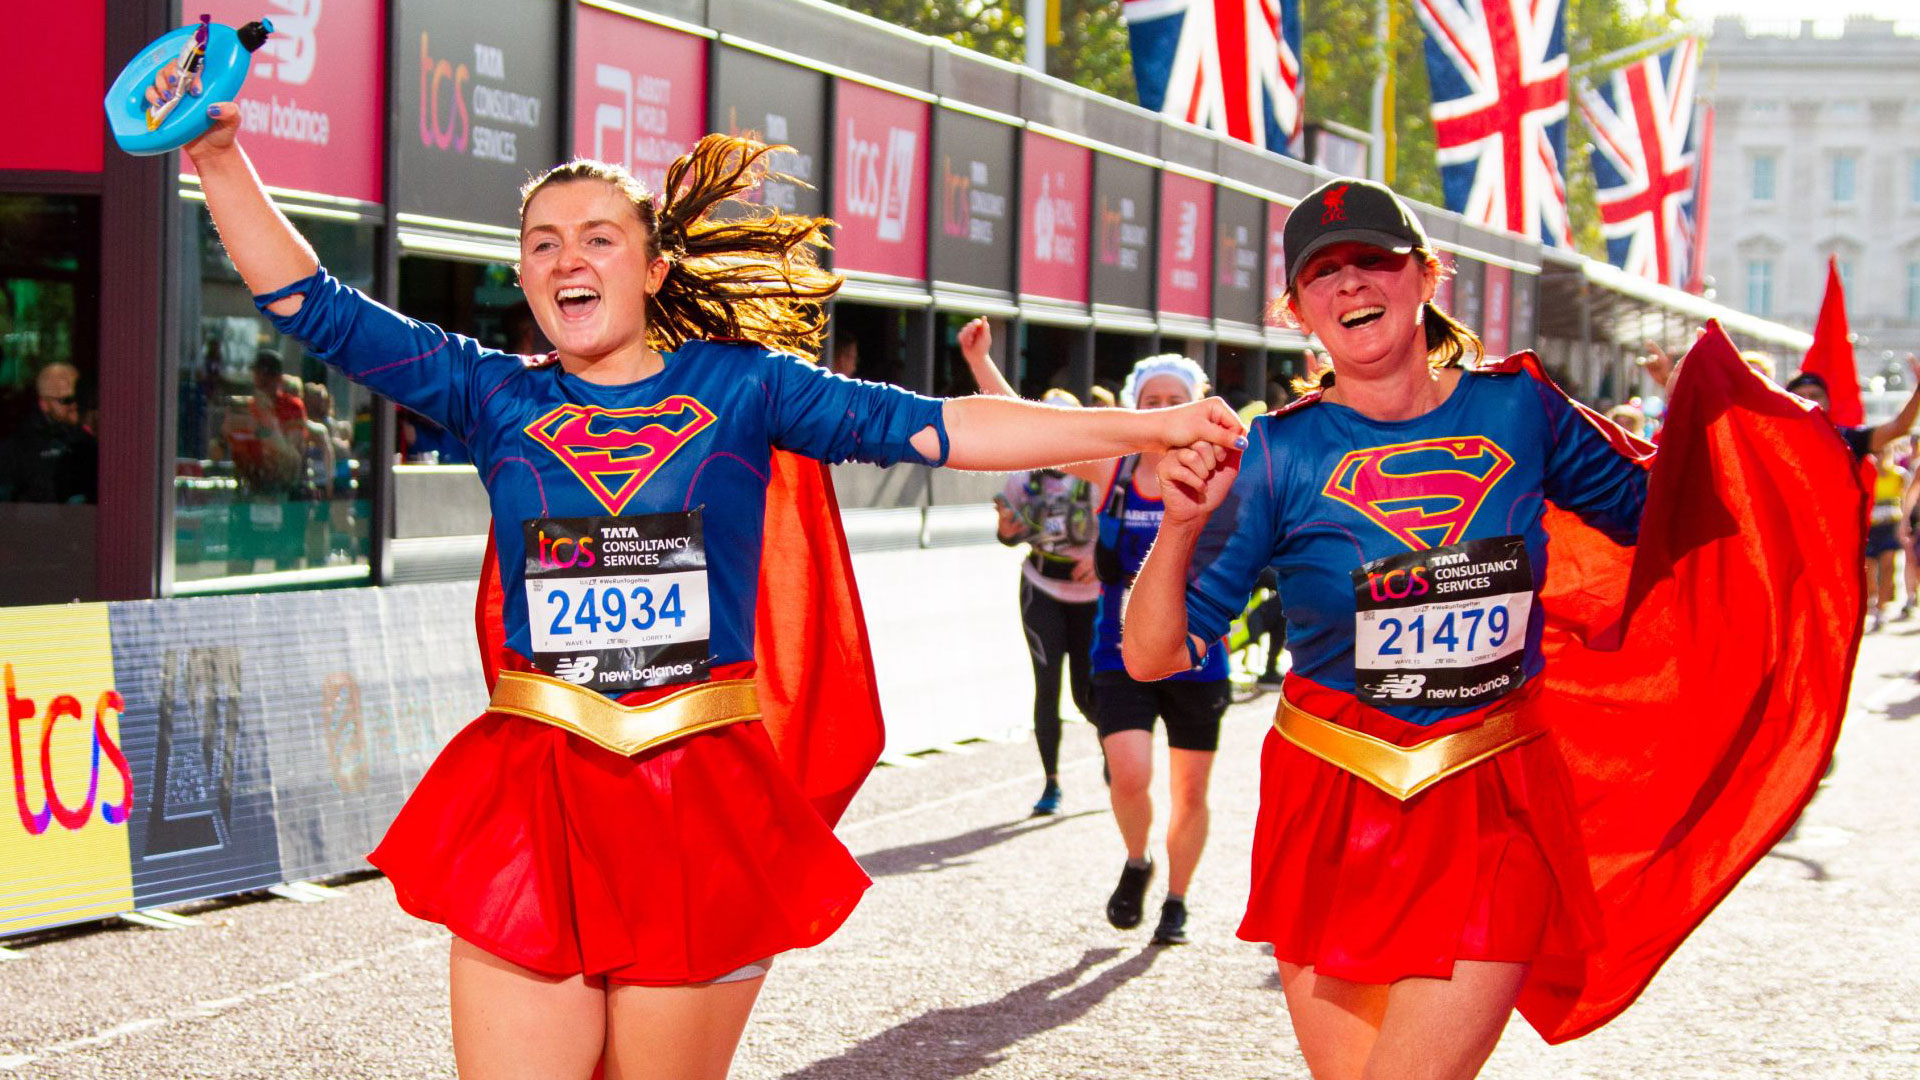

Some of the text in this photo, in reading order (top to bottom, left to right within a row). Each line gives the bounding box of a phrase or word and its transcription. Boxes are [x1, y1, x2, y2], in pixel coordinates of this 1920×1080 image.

[420, 30, 469, 153] tcs
[271, 95, 329, 147] balance
[846, 118, 880, 217] tcs
[601, 527, 639, 538] TATA
[602, 537, 691, 553] CONSULTANCY
[538, 530, 596, 569] tcs
[603, 553, 660, 567] SERVICES
[1431, 552, 1470, 567] TATA
[599, 577, 650, 586] #WeRunTogether
[1434, 559, 1518, 580] CONSULTANCY
[1368, 566, 1430, 602] tcs
[1436, 577, 1490, 594] SERVICES
[547, 583, 686, 635] 24934
[1378, 605, 1510, 656] 21479
[600, 669, 630, 683] new
[633, 663, 693, 681] balance
[1427, 688, 1458, 699] new
[1460, 674, 1510, 698] balance
[3, 662, 135, 836] tcs
